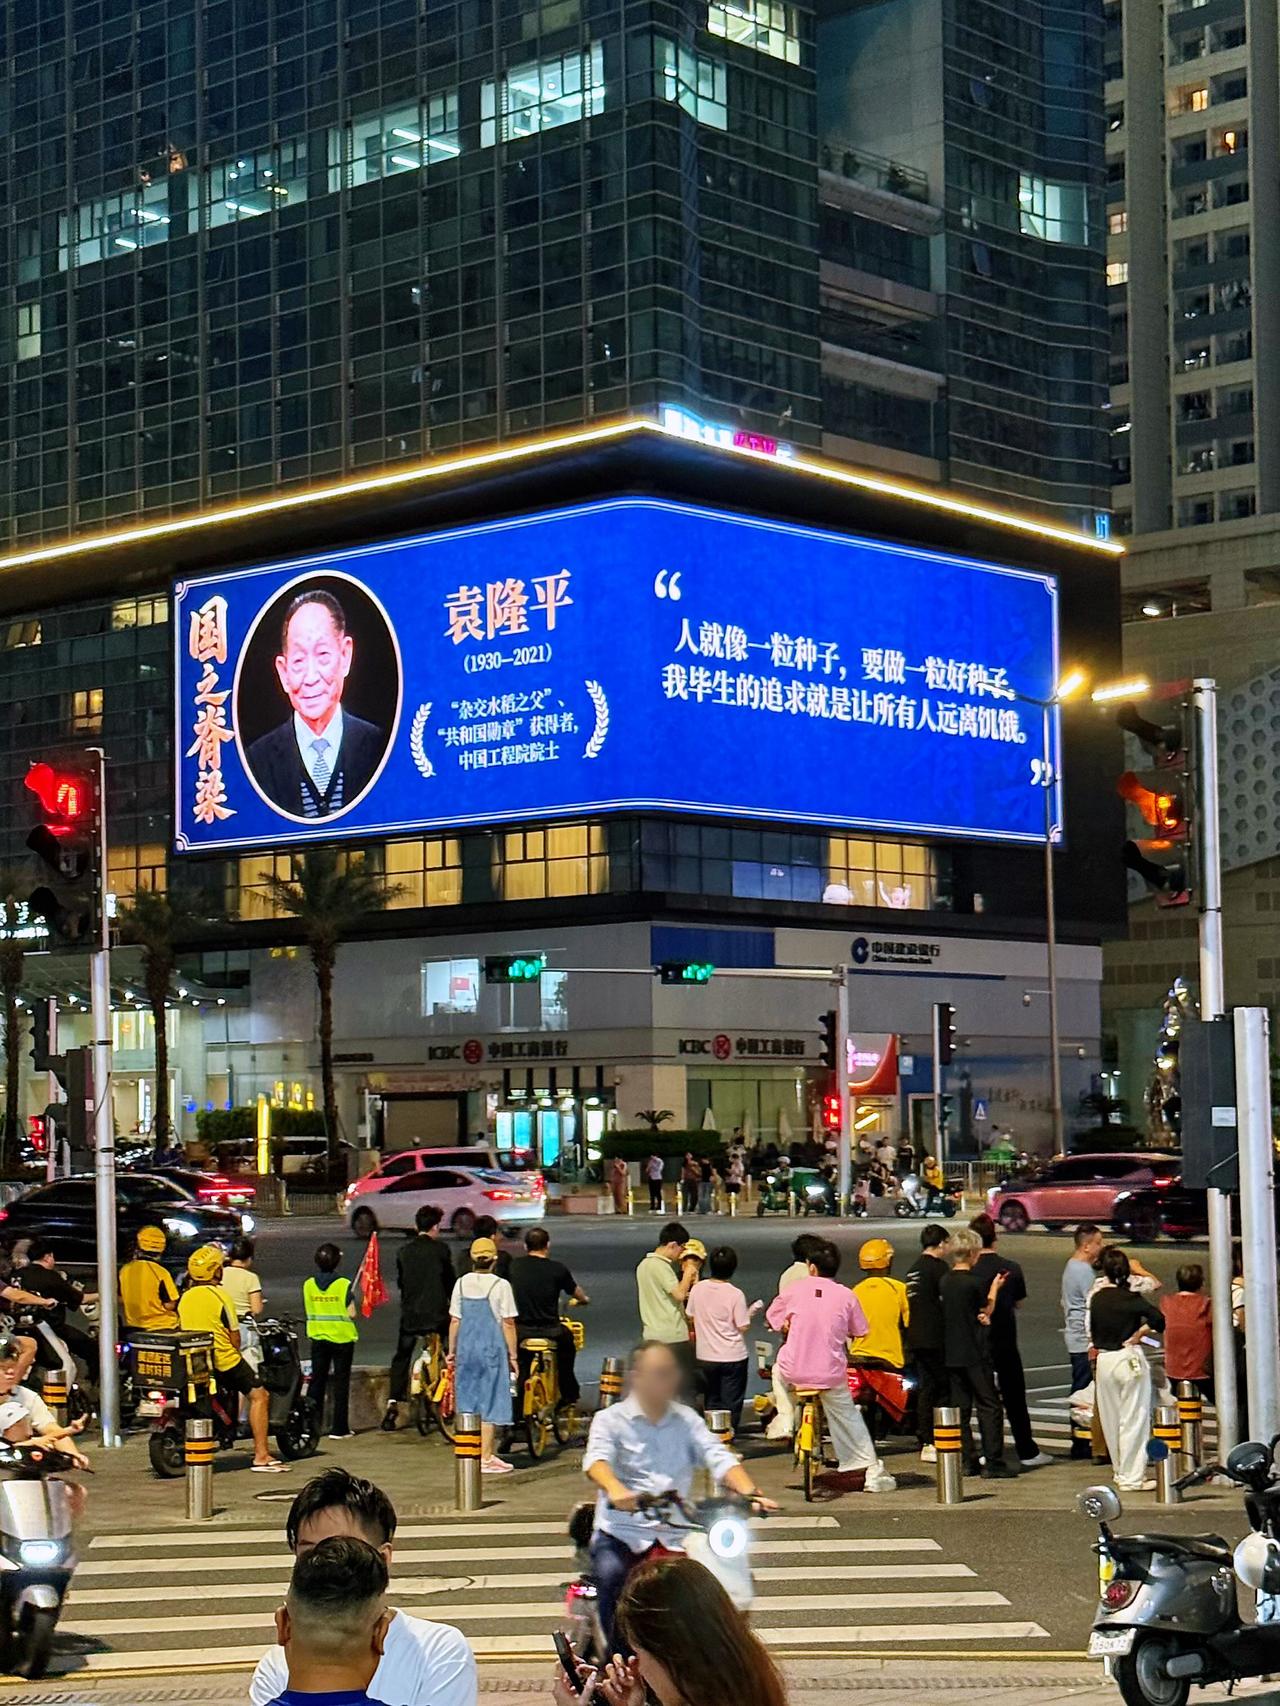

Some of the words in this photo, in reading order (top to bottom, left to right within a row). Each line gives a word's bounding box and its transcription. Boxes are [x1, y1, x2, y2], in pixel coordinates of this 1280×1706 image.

[443, 568, 573, 645] 袁隆平
[185, 595, 238, 825] 国之脊梁
[459, 740, 560, 771] 中国工程院院士
